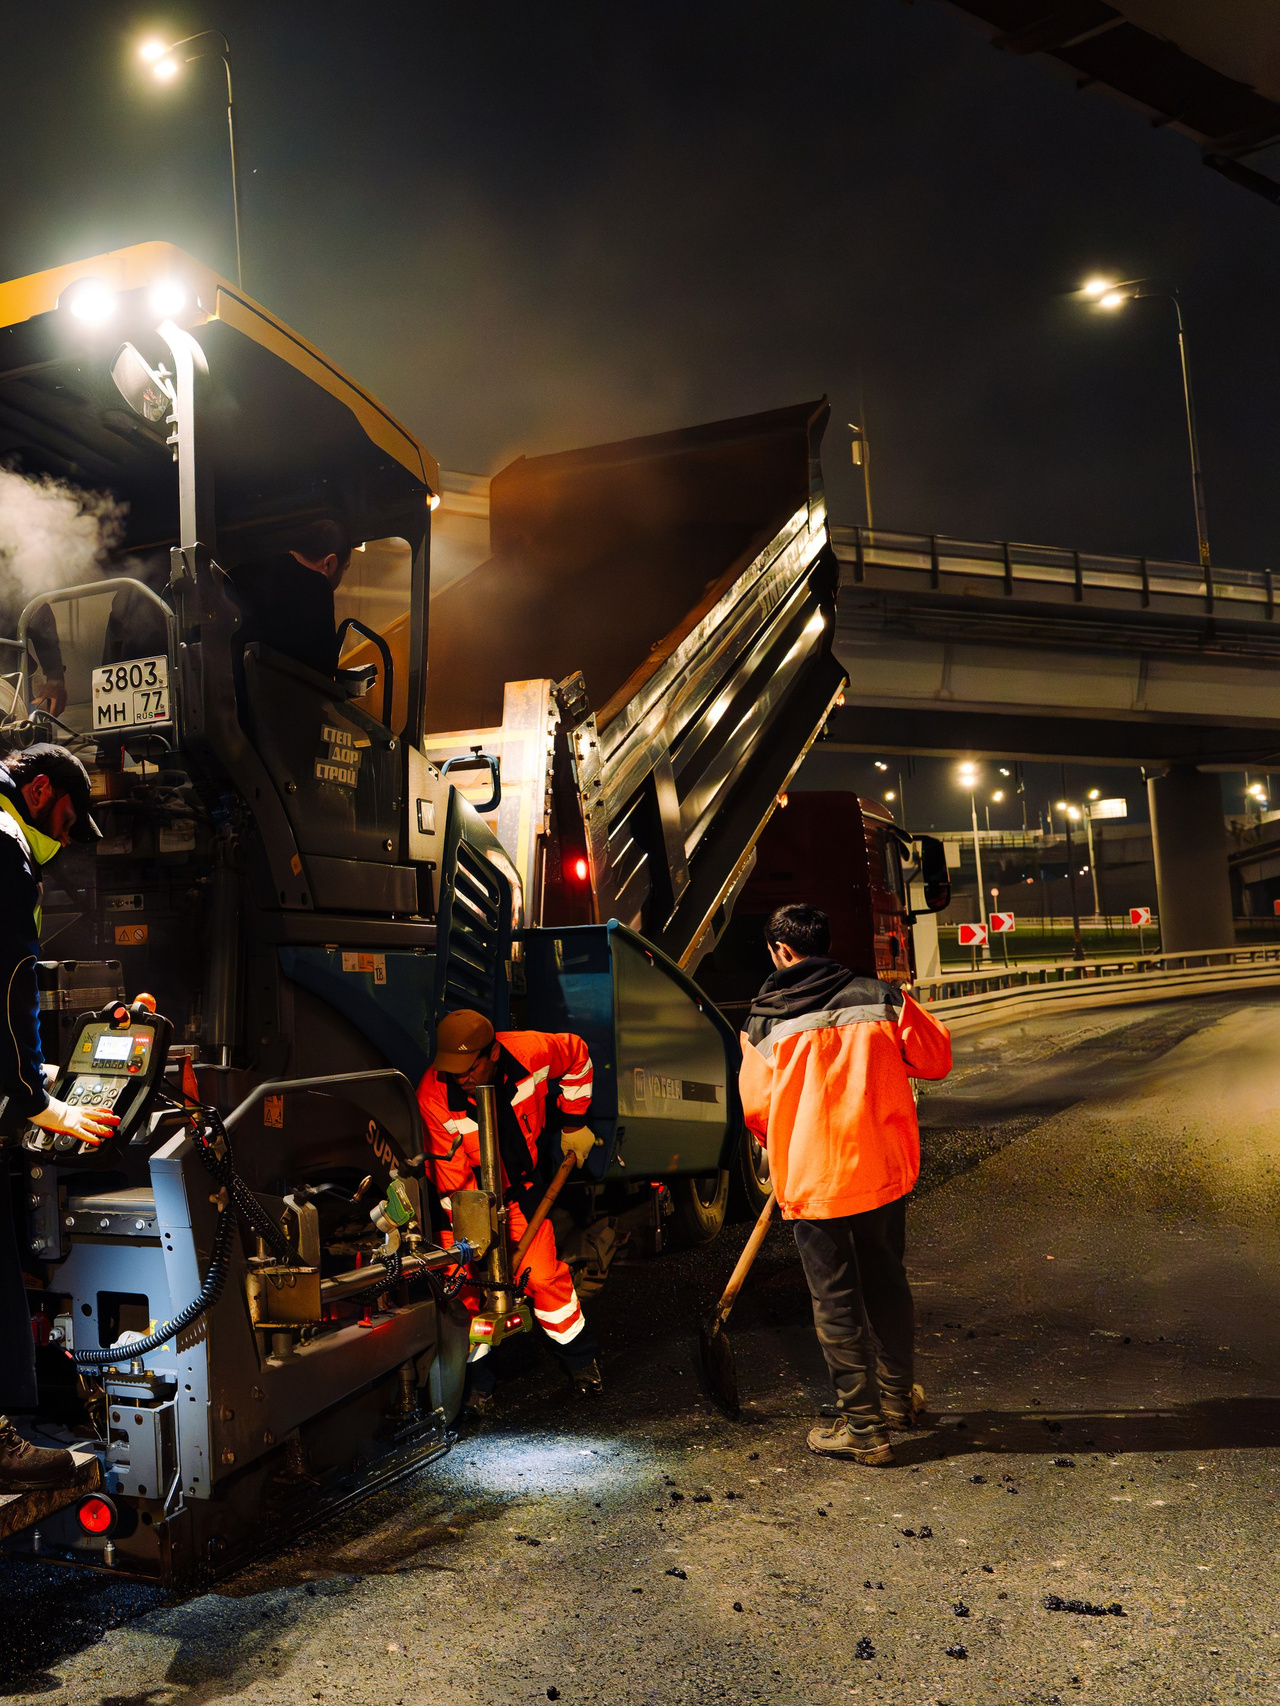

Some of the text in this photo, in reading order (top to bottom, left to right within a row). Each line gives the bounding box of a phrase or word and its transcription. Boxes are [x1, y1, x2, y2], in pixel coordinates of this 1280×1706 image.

[101, 661, 158, 692] 3803
[140, 691, 162, 712] 77
[136, 712, 154, 720] RUS
[332, 746, 359, 764] ДОР
[316, 764, 356, 785] СТРОЙ
